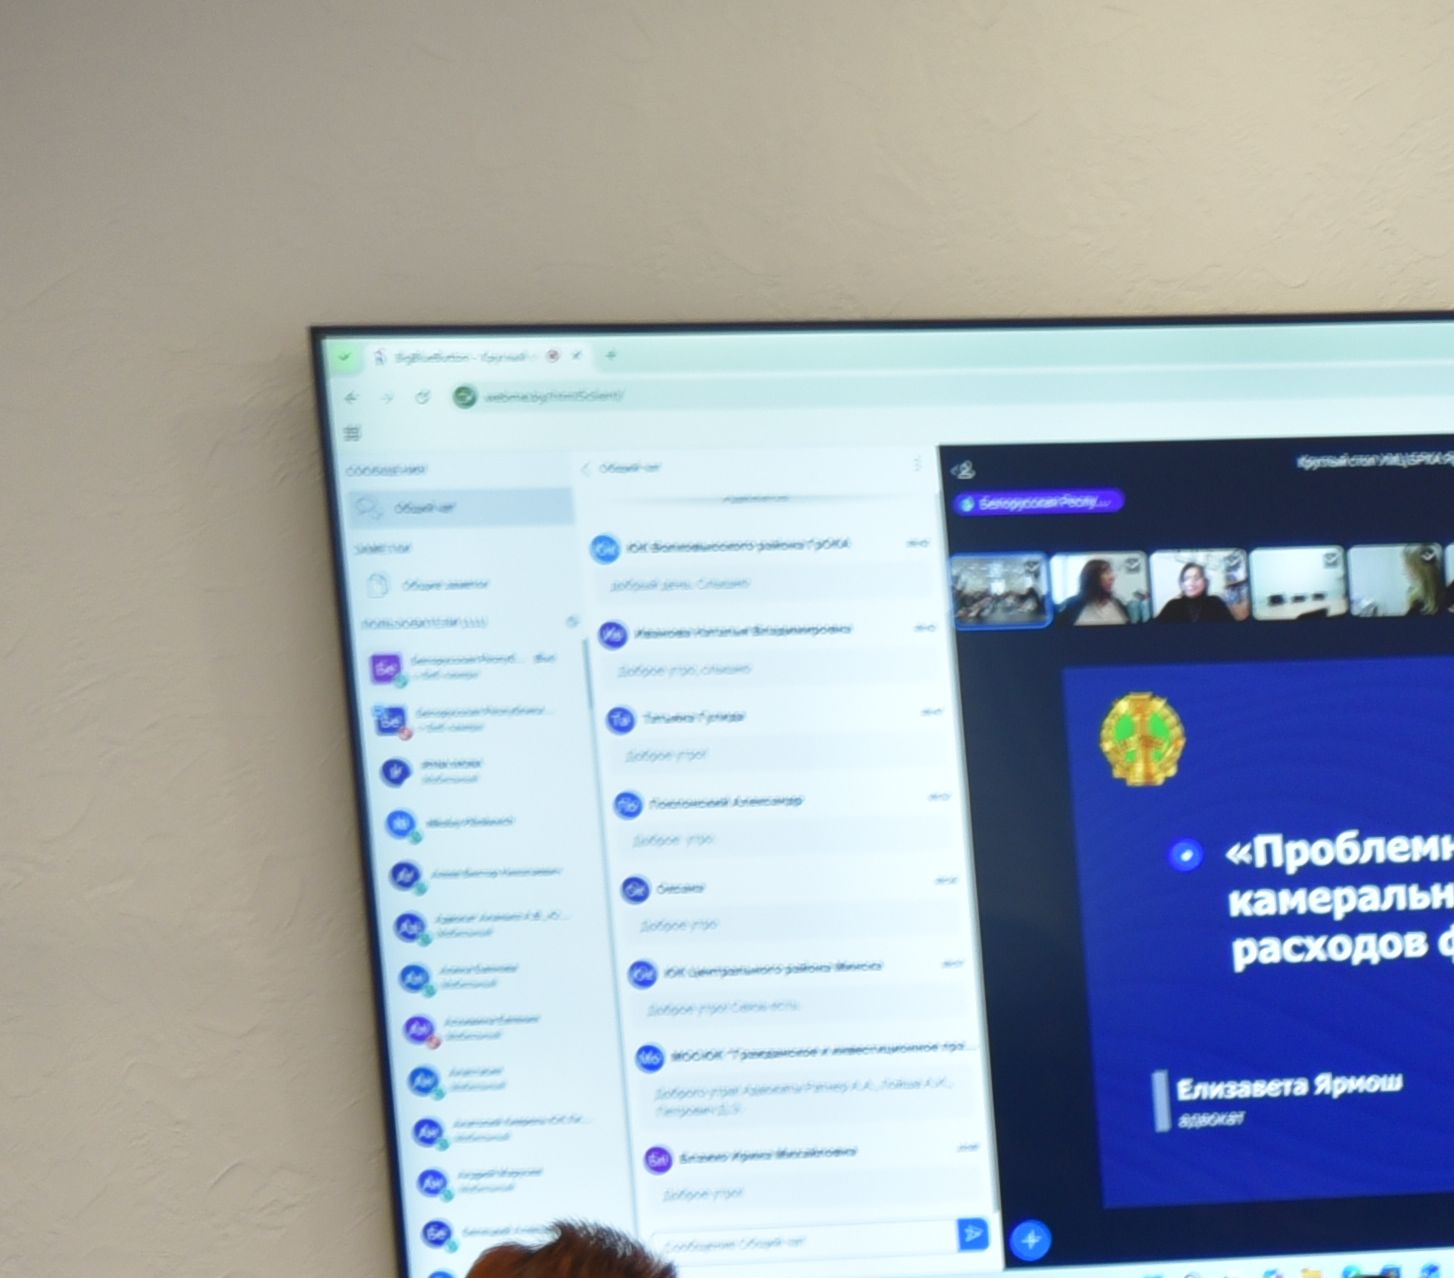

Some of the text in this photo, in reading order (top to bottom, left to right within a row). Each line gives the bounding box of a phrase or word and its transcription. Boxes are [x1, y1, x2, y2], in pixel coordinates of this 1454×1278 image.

[1231, 929, 1430, 974] расходов
[1175, 1069, 1406, 1103] Елизавета Ярмош
[1177, 1110, 1246, 1131] адвокат
